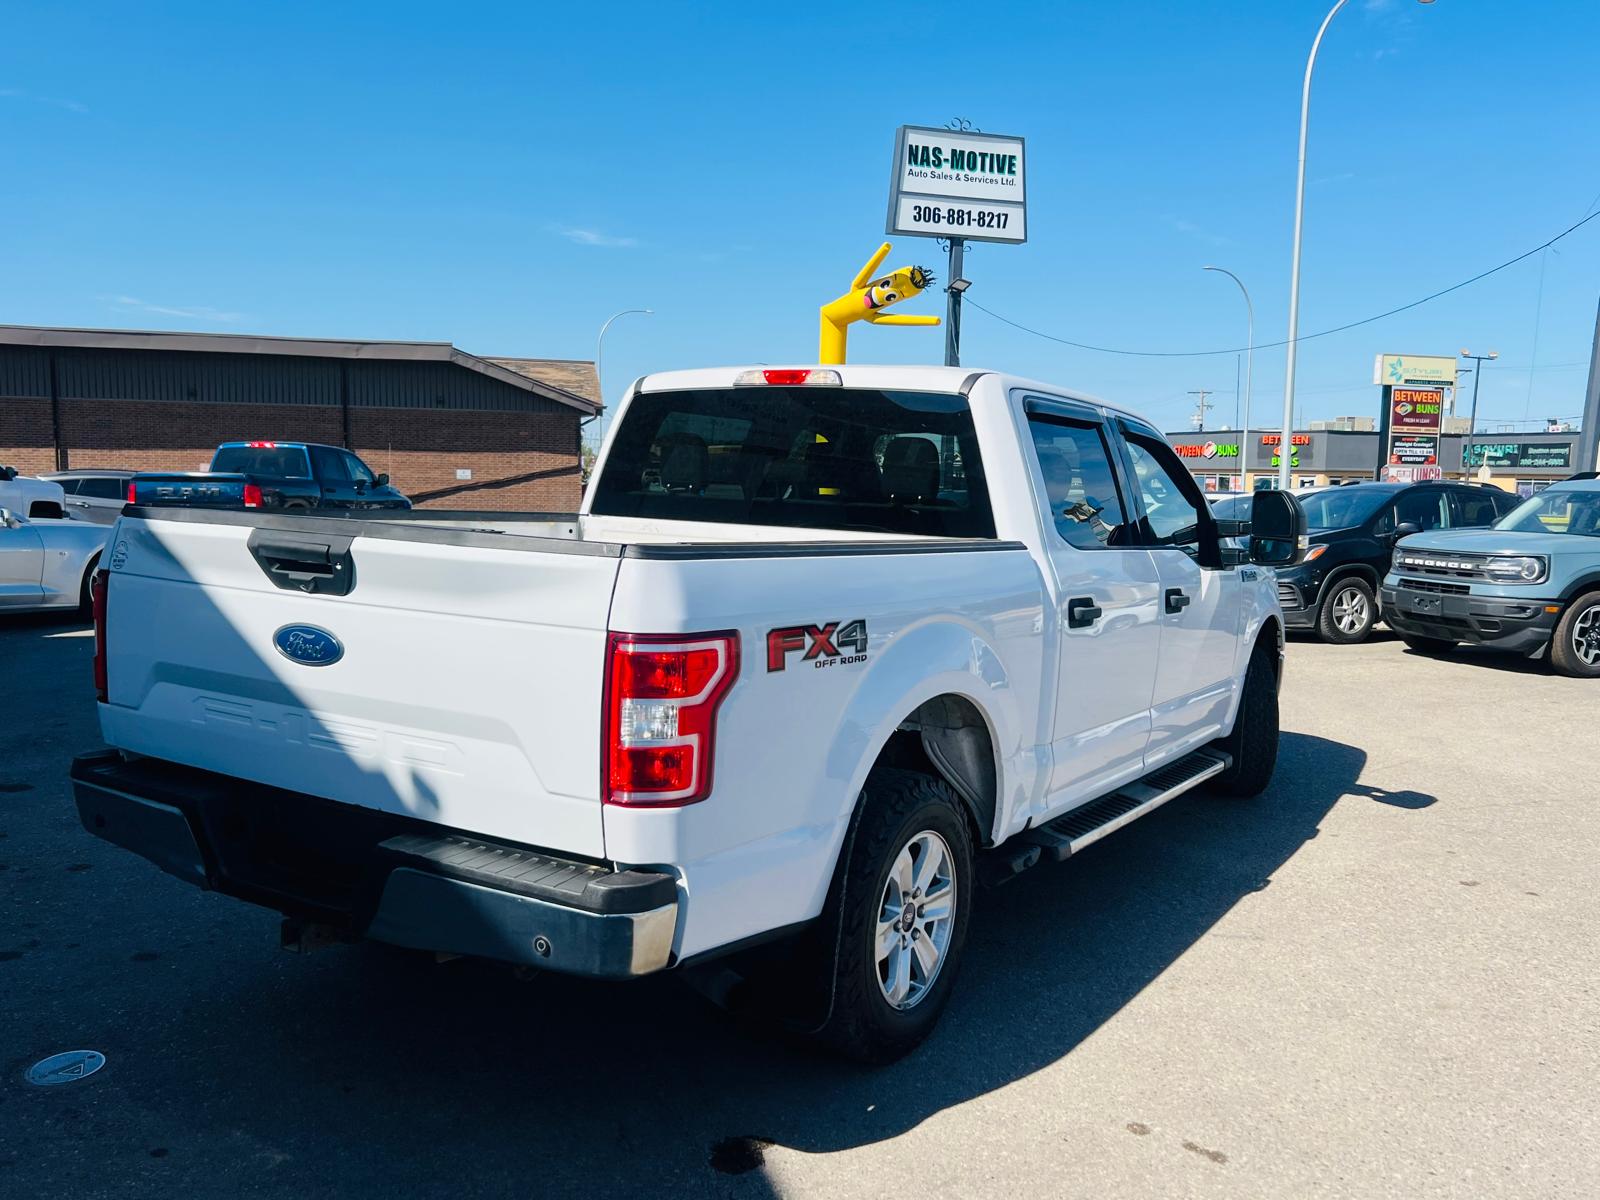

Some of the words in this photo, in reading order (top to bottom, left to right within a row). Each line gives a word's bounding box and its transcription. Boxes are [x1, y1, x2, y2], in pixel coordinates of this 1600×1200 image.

[908, 144, 1017, 177] NAS-MOTIVE
[907, 169, 928, 179] Auto
[930, 171, 953, 181] Sales
[955, 173, 961, 181] &
[963, 174, 999, 185] Services
[1001, 177, 1016, 186] Ltd.
[913, 205, 1008, 229] 306-881-8217
[1394, 390, 1440, 403] BETWEEN
[1416, 403, 1440, 414] BUNS
[1262, 436, 1309, 445] BETEEN
[1218, 445, 1238, 457] BUNS
[1411, 468, 1440, 480] LUNCH
[156, 487, 220, 498] RAM
[1404, 558, 1473, 569] BRONCO
[766, 619, 868, 673] FX4
[815, 659, 837, 669] OFF
[840, 654, 868, 665] ROAD
